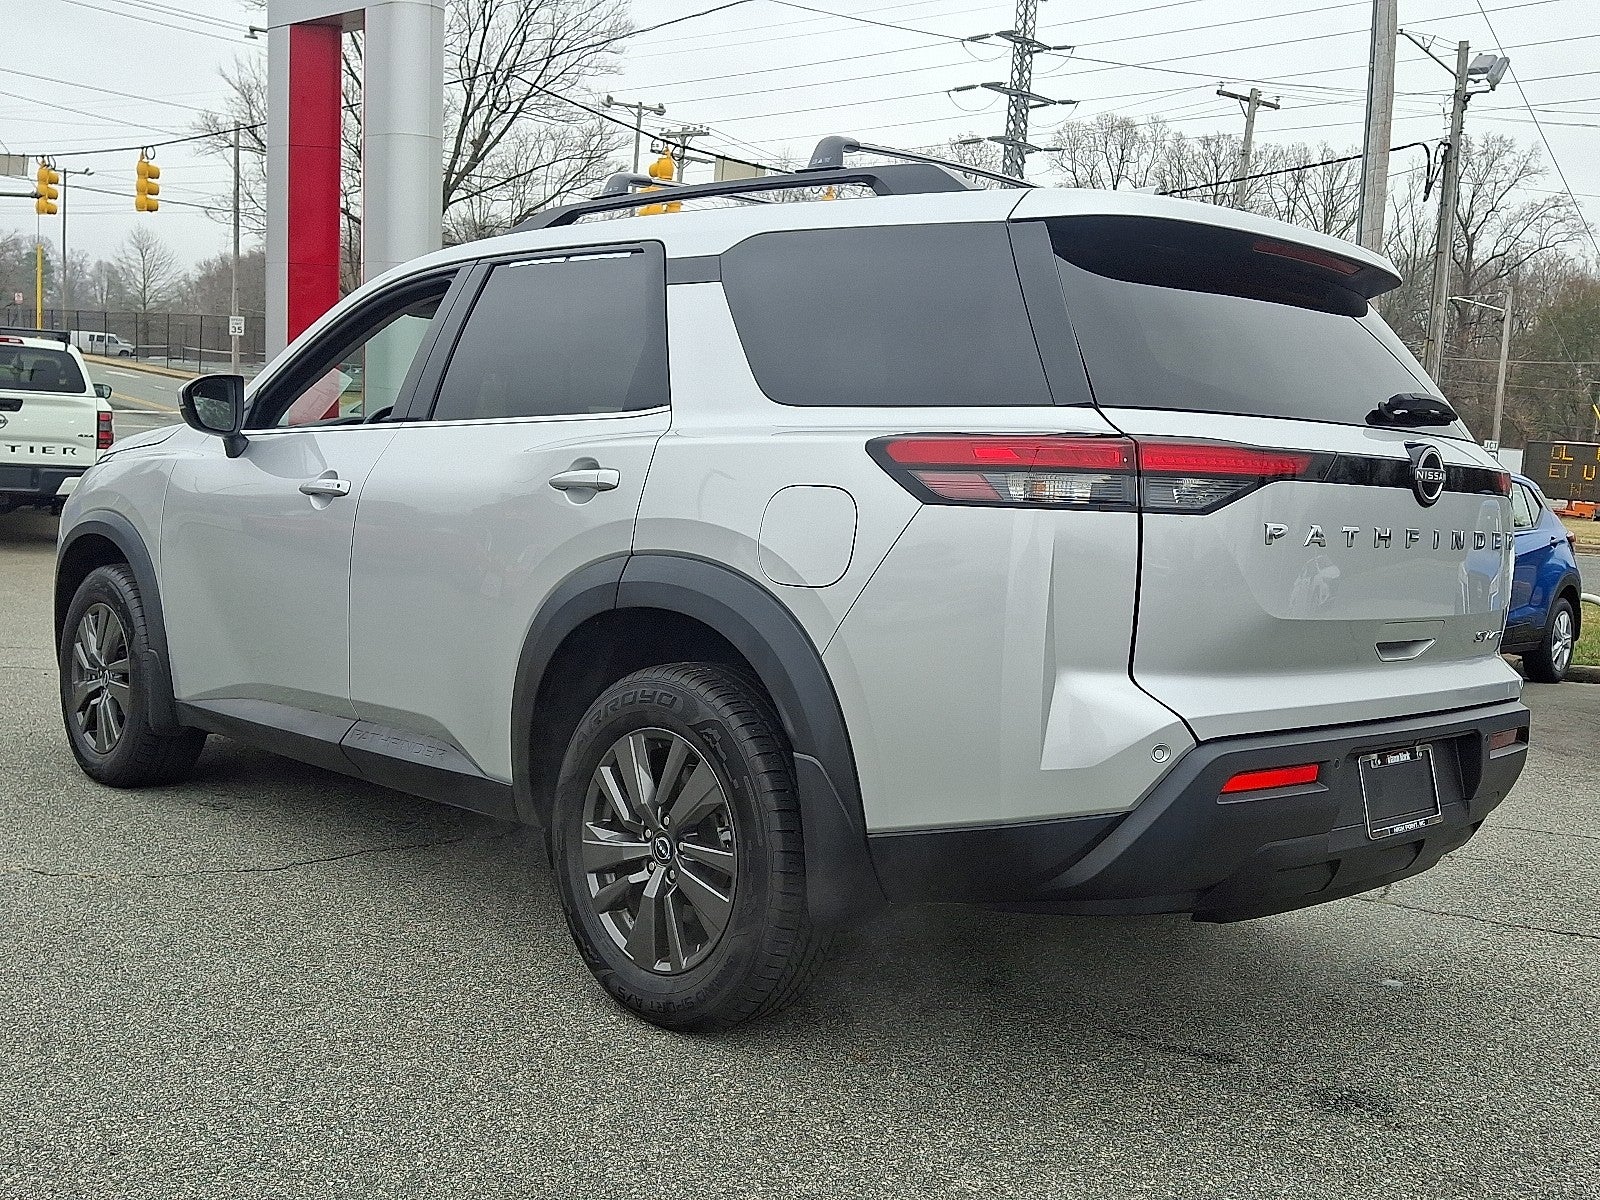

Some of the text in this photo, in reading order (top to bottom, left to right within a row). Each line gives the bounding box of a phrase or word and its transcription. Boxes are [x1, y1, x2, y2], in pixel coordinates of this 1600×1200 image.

[5, 444, 77, 456] TIER
[1484, 441, 1498, 450] JCT
[1416, 470, 1446, 481] NISSA
[1263, 521, 1514, 551] PATHFINDER
[350, 727, 449, 760] PATHFINDER
